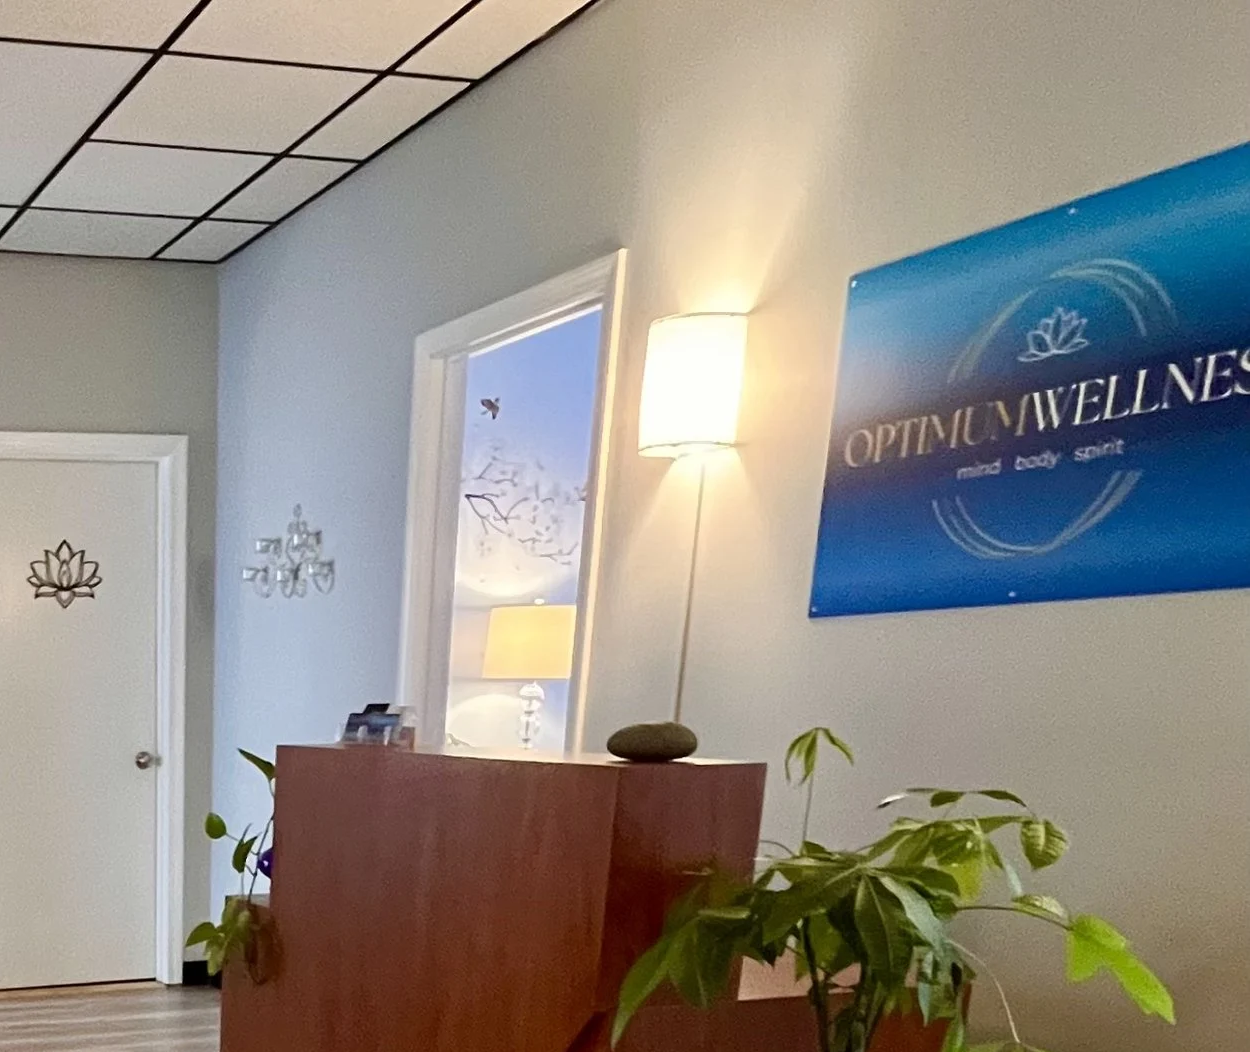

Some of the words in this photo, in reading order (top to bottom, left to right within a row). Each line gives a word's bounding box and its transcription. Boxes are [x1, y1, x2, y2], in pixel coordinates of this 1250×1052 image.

[956, 458, 1002, 481] mind
[1014, 450, 1061, 471] body
[1073, 438, 1125, 462] spirit
